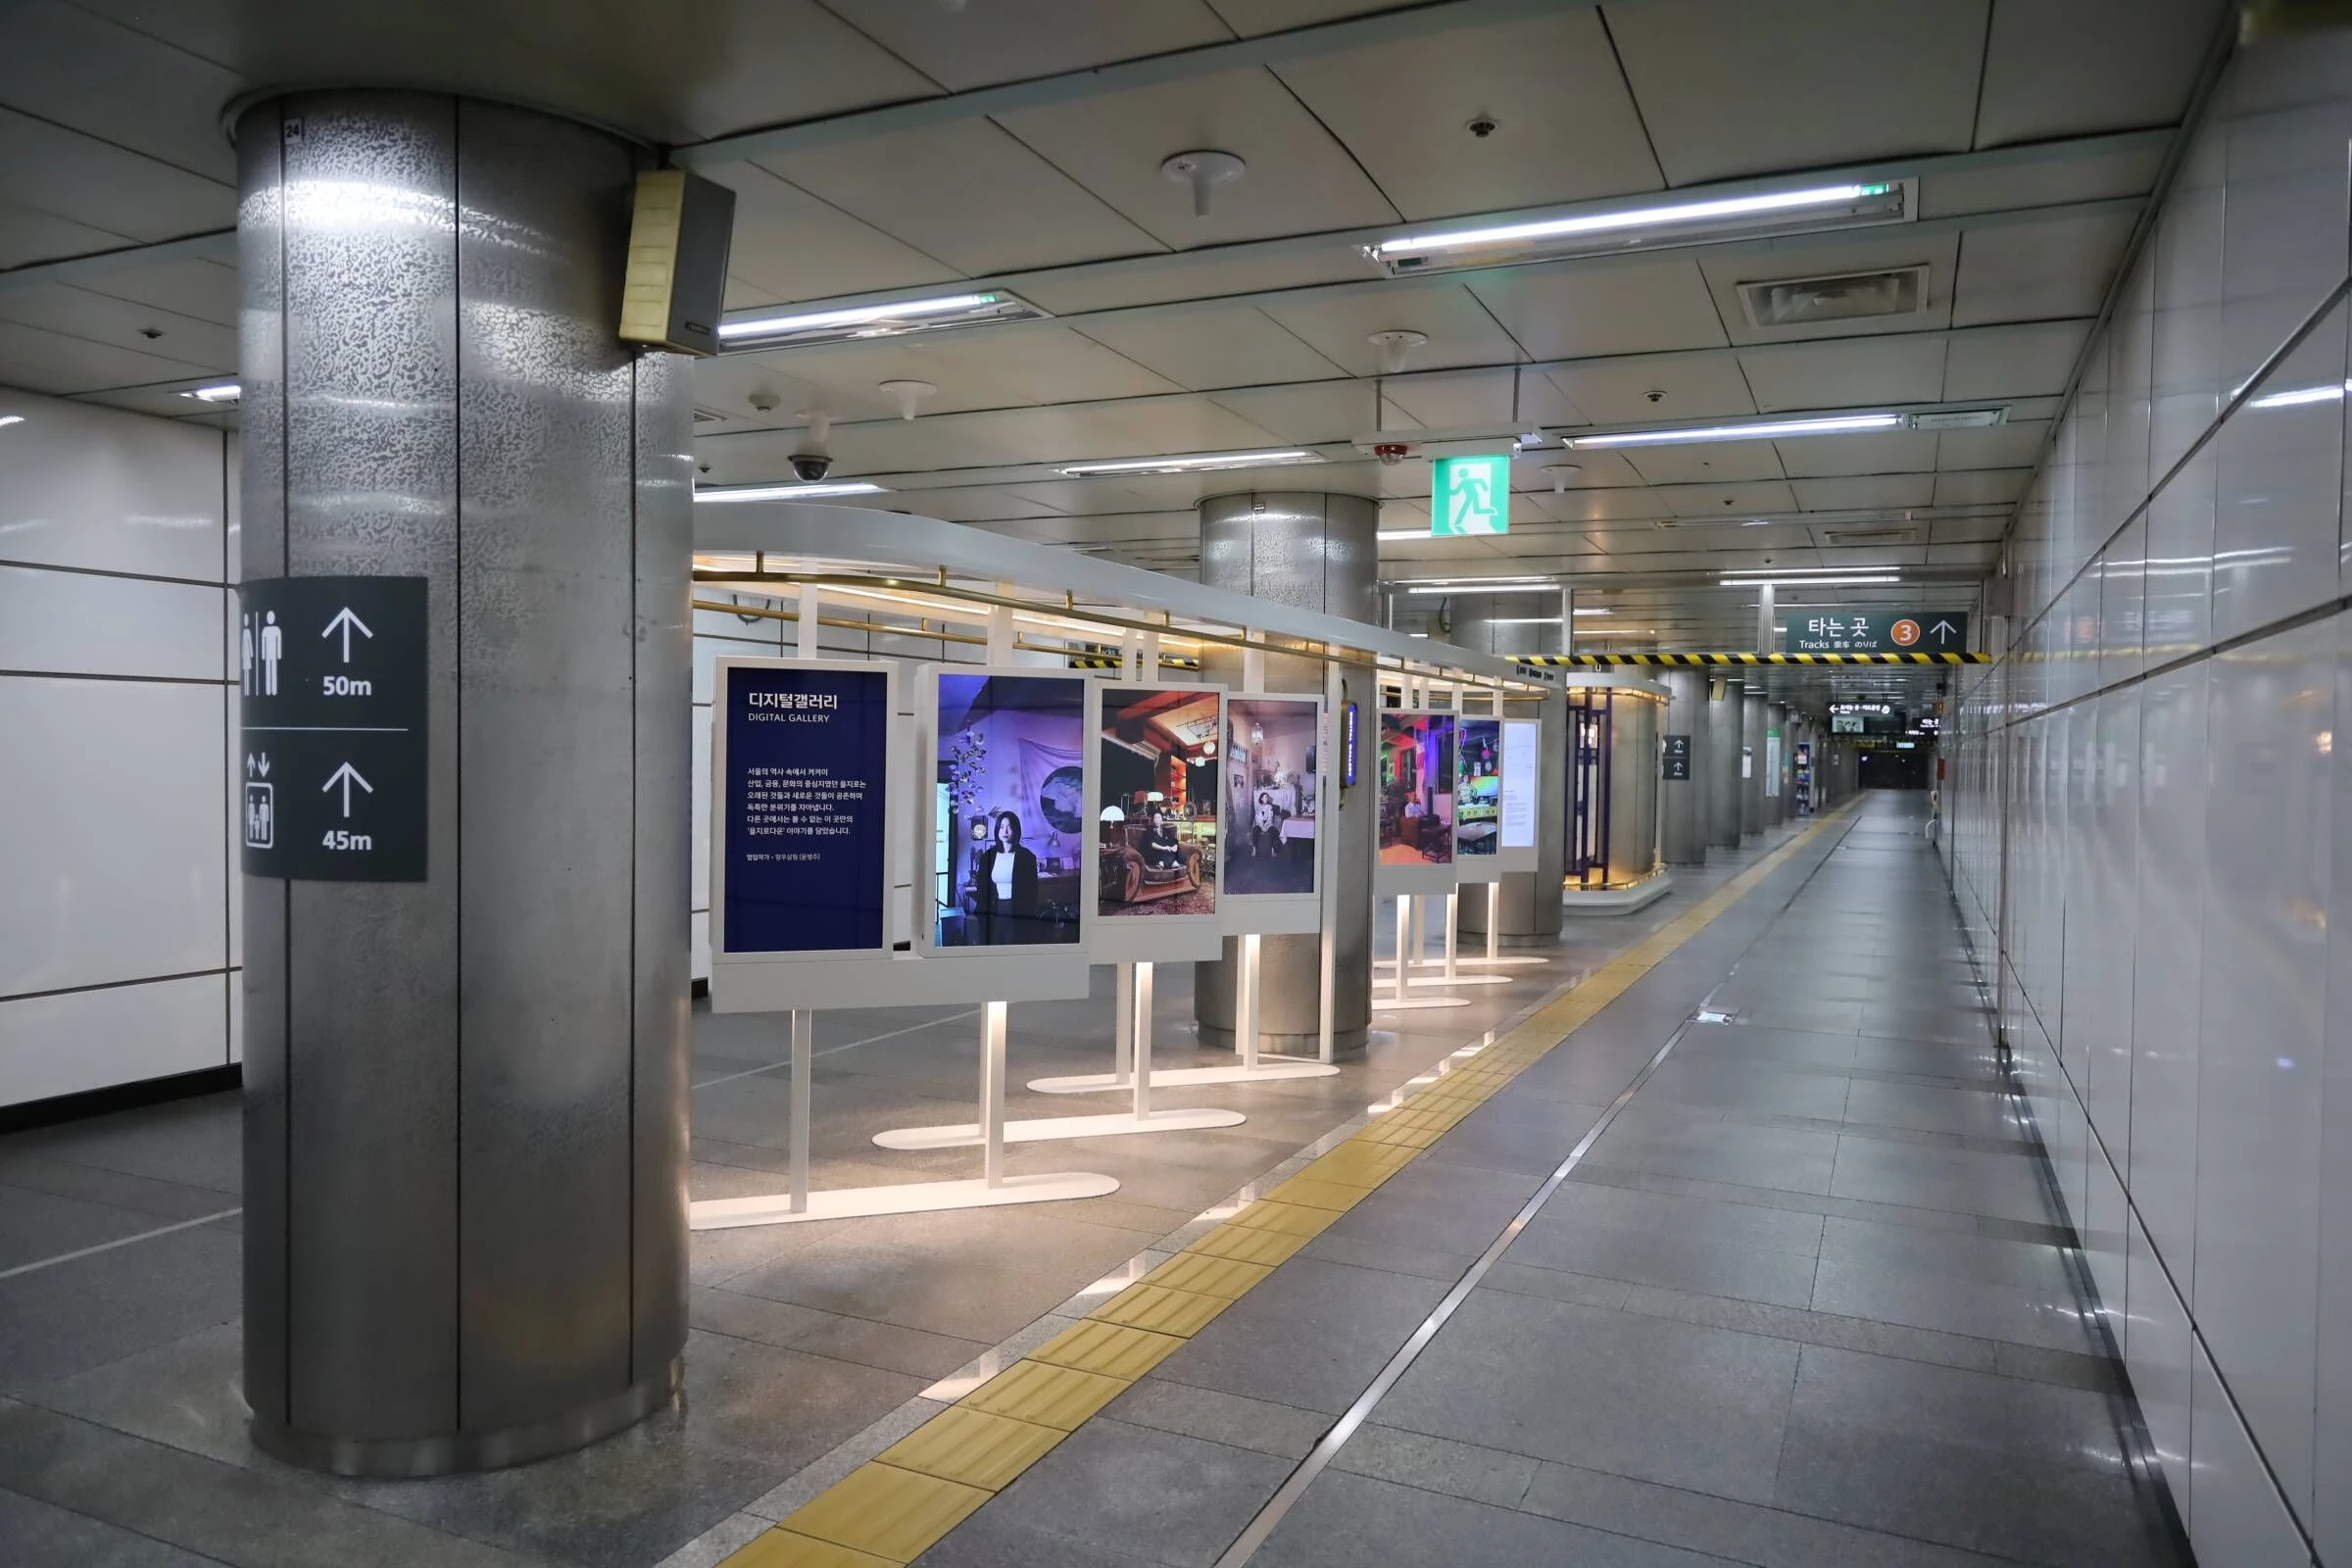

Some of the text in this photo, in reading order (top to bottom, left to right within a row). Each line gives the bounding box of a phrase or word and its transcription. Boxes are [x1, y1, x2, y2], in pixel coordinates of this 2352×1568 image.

[286, 123, 299, 138] 24
[1808, 617, 1869, 637] 타는 곳
[1900, 624, 1912, 641] 3
[1799, 640, 1830, 649] Tracks
[322, 676, 371, 696] 50m
[749, 692, 838, 710] 디지털갤러리
[749, 713, 830, 723] DIGITAL GALLERY
[747, 767, 768, 776] 서울의
[770, 767, 784, 776] 역사
[824, 815, 831, 824] 이
[322, 831, 371, 850] 45m
